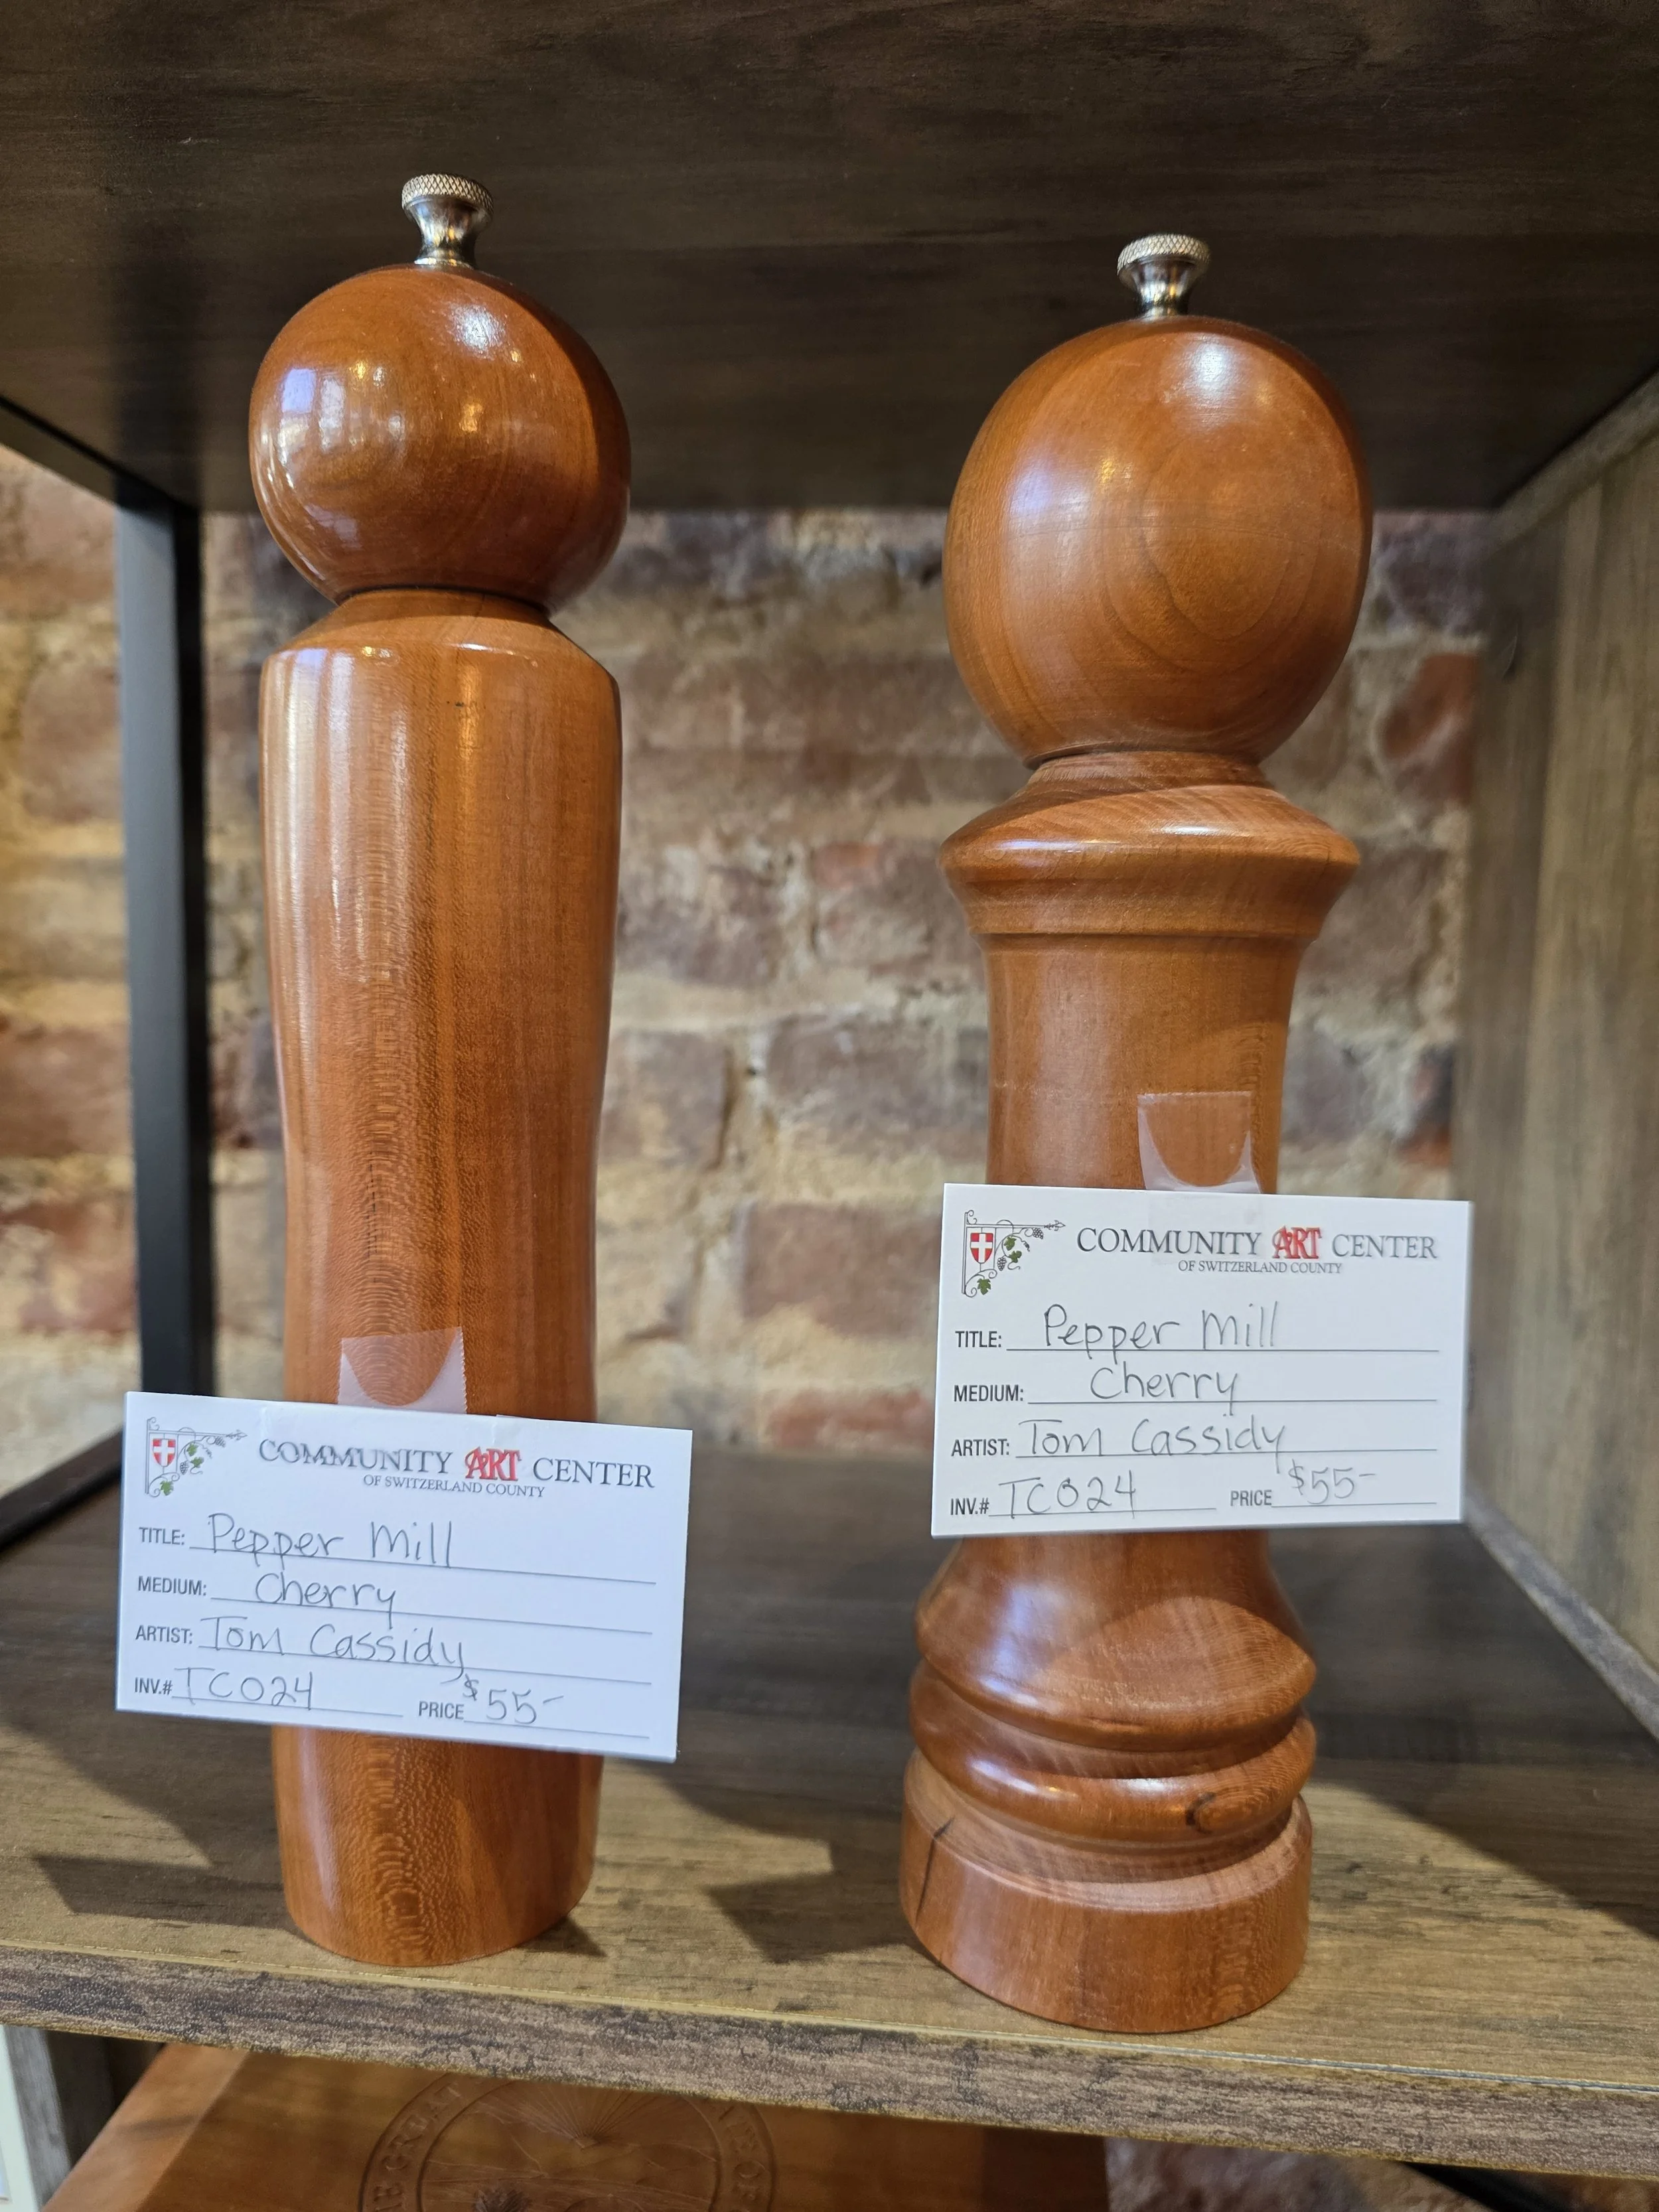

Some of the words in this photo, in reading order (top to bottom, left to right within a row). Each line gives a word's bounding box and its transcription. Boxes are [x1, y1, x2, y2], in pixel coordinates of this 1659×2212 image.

[1077, 1227, 1262, 1256] COMMUNITY
[1272, 1226, 1322, 1260] ART
[1333, 1234, 1437, 1259] CENTER
[1179, 1260, 1195, 1272] OF
[1198, 1260, 1287, 1274] SWITZERLAND
[1291, 1262, 1342, 1274] COUNTY
[956, 1331, 1002, 1349] TITLE:
[1043, 1303, 1180, 1365] Pepper
[1202, 1301, 1279, 1350] Mill
[954, 1385, 1023, 1402] MEDIUM:
[1091, 1361, 1238, 1415] Cherry
[259, 1439, 452, 1474] COMMUNITY
[465, 1448, 520, 1481] ART
[533, 1457, 654, 1488] CENTER
[951, 1439, 1009, 1456] ARTIST:
[1019, 1420, 1102, 1456] Tom
[1132, 1415, 1285, 1473] Cassidy
[364, 1475, 382, 1485] OF
[385, 1477, 482, 1494] SWITZERLAND
[486, 1482, 545, 1497] COUNTY
[1230, 1489, 1272, 1507] PRICE
[950, 1499, 989, 1515] INV.#
[139, 1527, 186, 1546] TITLE:
[208, 1513, 343, 1568] Pepper
[371, 1521, 453, 1568] Mill
[137, 1578, 206, 1596] MEDIUM:
[255, 1572, 396, 1631] Cherry
[135, 1625, 193, 1645] ARTIST:
[201, 1617, 283, 1654] Tom
[311, 1624, 465, 1684] Cassidy
[135, 1678, 173, 1696] INV.#
[418, 1701, 464, 1720] PRICE
